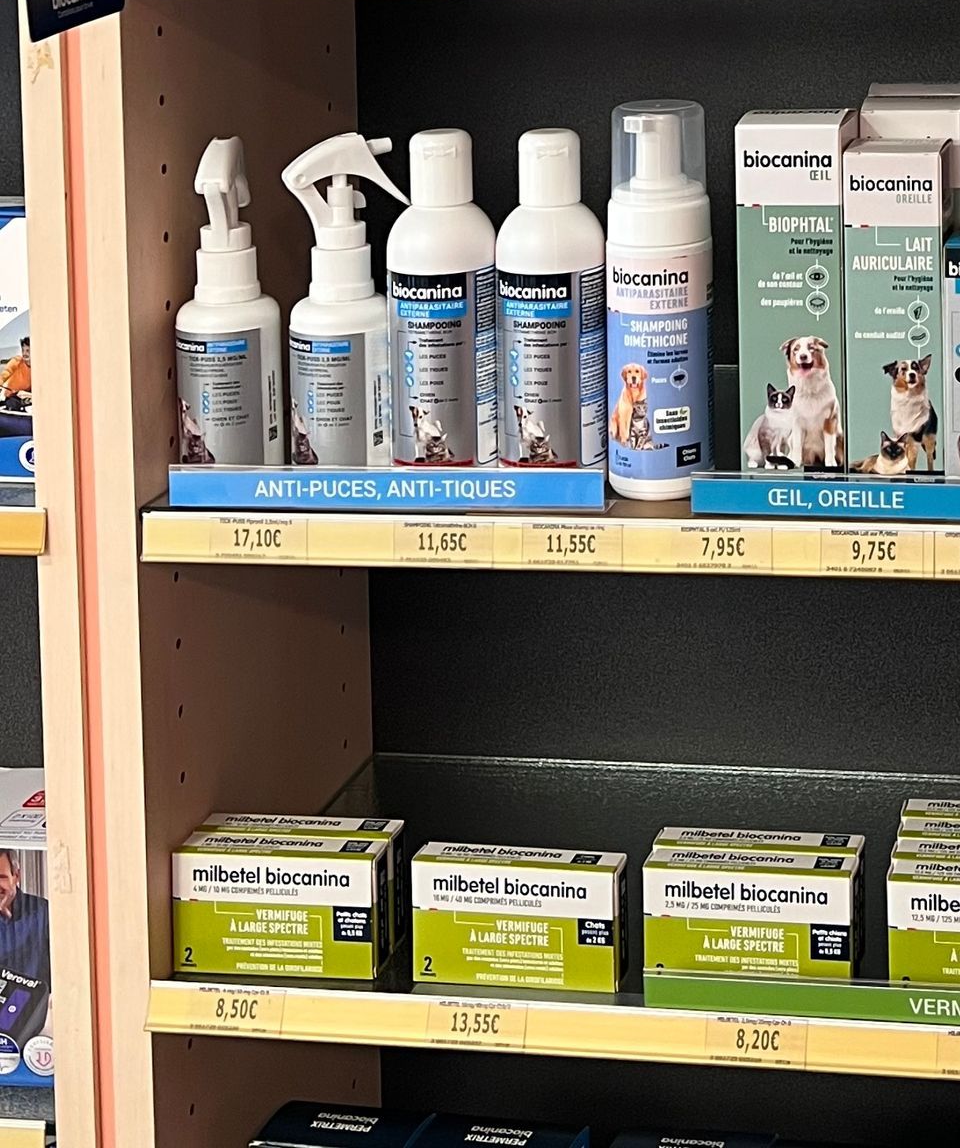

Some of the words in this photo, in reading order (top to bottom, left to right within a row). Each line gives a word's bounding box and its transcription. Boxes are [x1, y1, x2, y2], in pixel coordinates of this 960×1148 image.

[744, 150, 832, 167] biocanina
[810, 170, 831, 180] ŒIL
[850, 175, 932, 192] biocanina
[896, 194, 932, 203] OREILLE
[769, 217, 833, 233] BIOPHTAL
[906, 237, 932, 252] LAIT
[852, 256, 933, 271] AURICULAIRE
[613, 266, 689, 286] biocanina
[392, 282, 462, 299] biocanina
[400, 302, 464, 311] ANTIPARASITAIRE
[400, 310, 430, 318] EXTERNE
[630, 319, 688, 333] SHAMPOING
[624, 332, 688, 347] DIMÉTHICONE
[254, 480, 382, 501] ANTI-PUCES,
[387, 479, 516, 499] ANTI-TIQUES
[768, 488, 812, 510] ŒIL,
[818, 489, 904, 509] OREILLE
[233, 529, 281, 549] 17,10€
[418, 532, 467, 553] 11,65€
[546, 534, 596, 555] 11,55€
[701, 537, 745, 559] 7,95€
[852, 541, 896, 563] 9,75€
[193, 865, 260, 884] milbetel
[266, 868, 350, 887] biocanina
[433, 875, 498, 894] milbetel
[504, 878, 587, 899] biocanina
[665, 881, 735, 900] milbetel
[741, 884, 828, 905] biocanina
[256, 910, 308, 922] VERMIFUGE
[230, 918, 237, 932] À
[238, 921, 267, 933] LARGE
[269, 923, 308, 934] SPECTRE
[184, 947, 193, 962] 2
[1, 969, 38, 990] Veroval
[216, 998, 258, 1022] 8,50€
[451, 1012, 500, 1036] 13,55€
[736, 1029, 780, 1053] 8,20€
